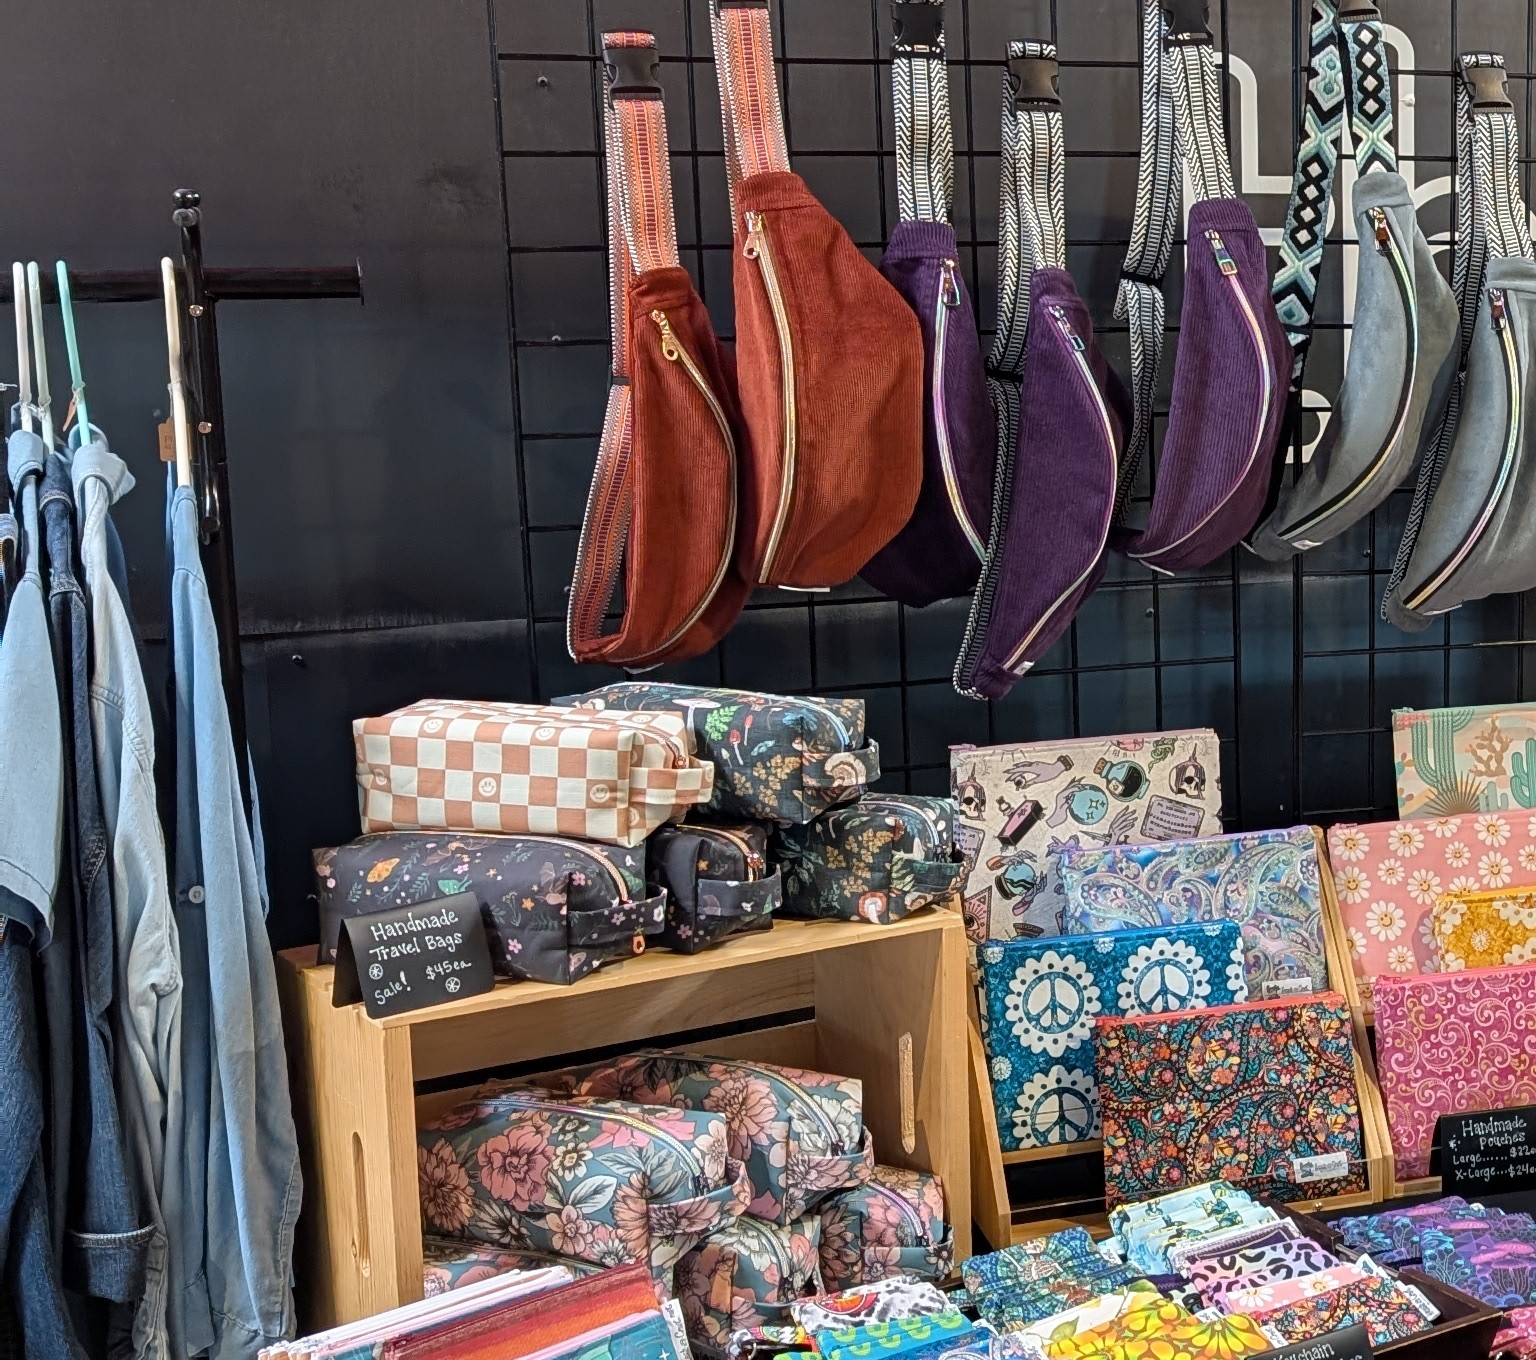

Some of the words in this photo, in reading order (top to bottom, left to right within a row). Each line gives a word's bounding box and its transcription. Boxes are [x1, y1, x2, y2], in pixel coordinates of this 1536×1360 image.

[370, 908, 459, 941] Handmade
[369, 937, 421, 961] Travel
[425, 931, 463, 953] Bags
[374, 971, 411, 1005] Sale!
[1461, 1115, 1527, 1137] Handmade
